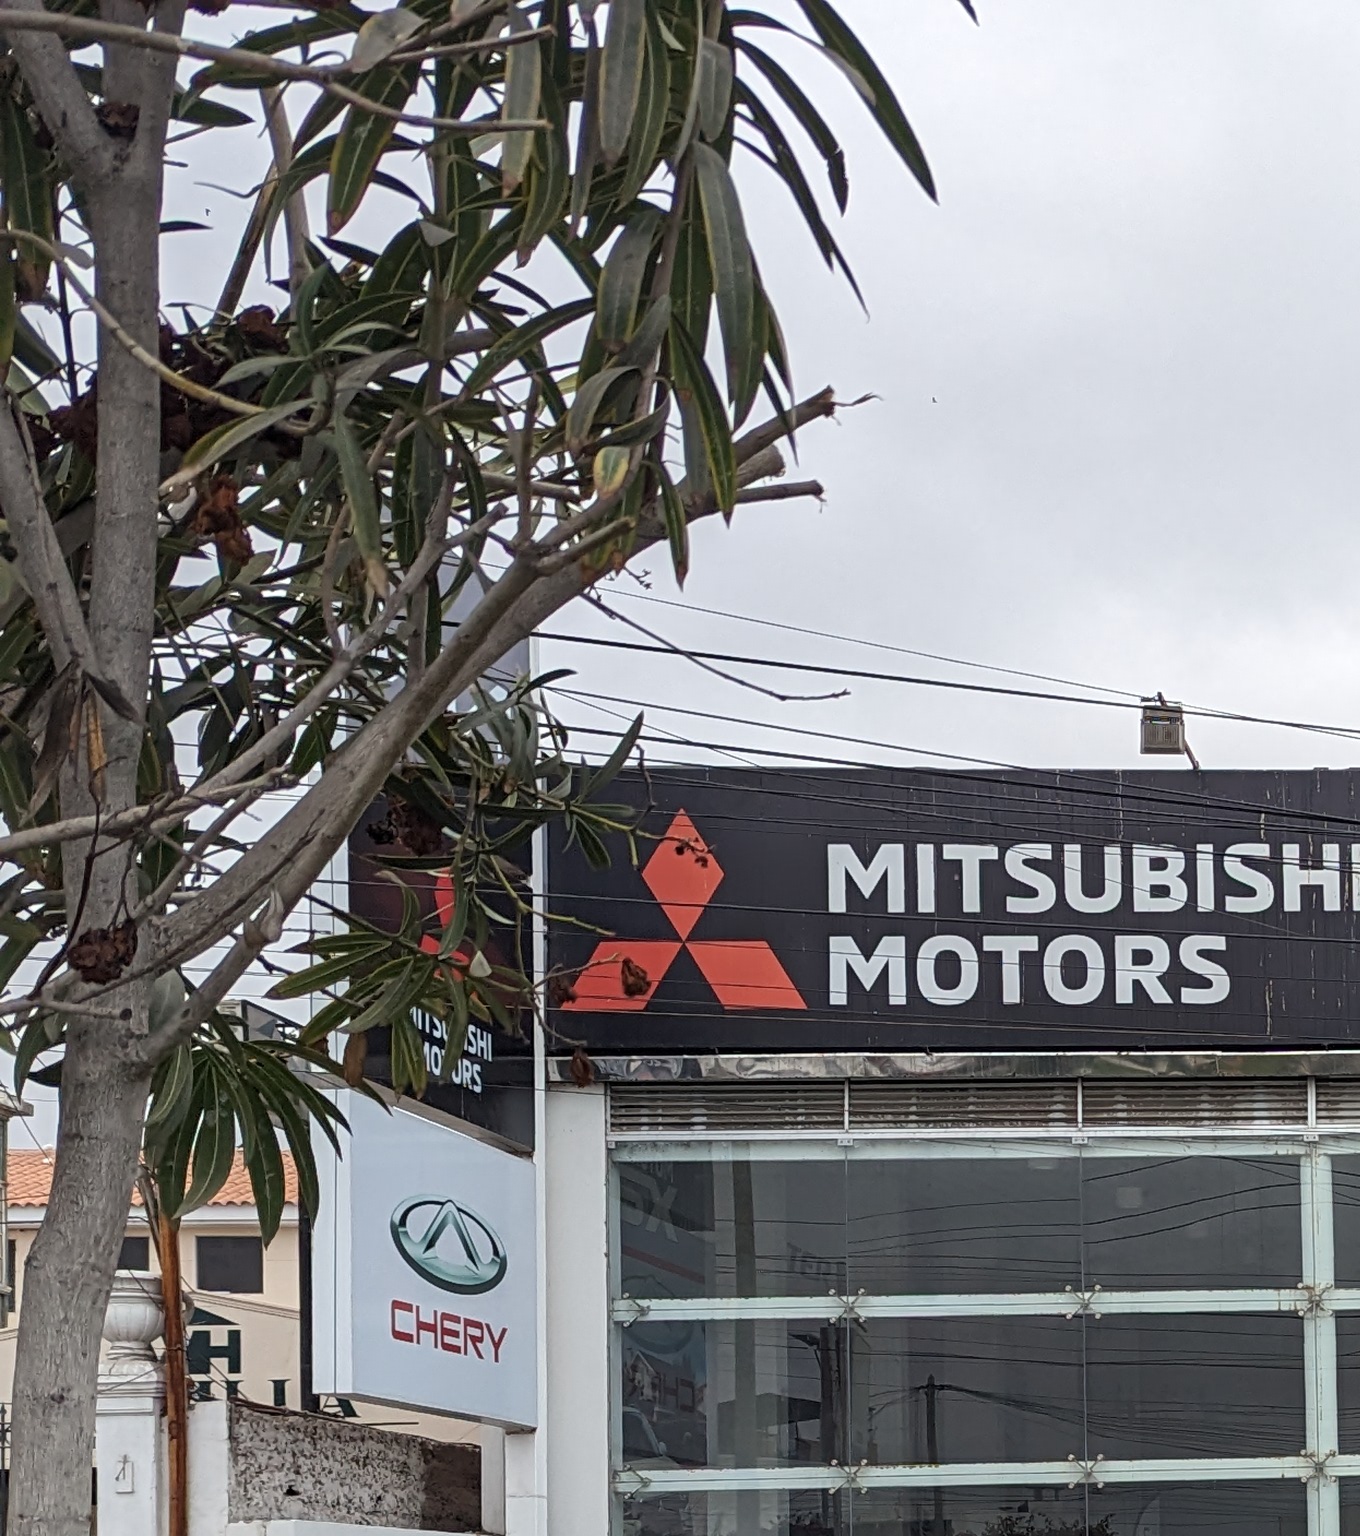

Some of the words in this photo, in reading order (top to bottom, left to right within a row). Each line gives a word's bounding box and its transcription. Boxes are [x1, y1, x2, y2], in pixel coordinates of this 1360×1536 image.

[828, 934, 1232, 1006] MOTORS
[424, 1041, 482, 1093] MOORS
[391, 1299, 508, 1363] CHERY
